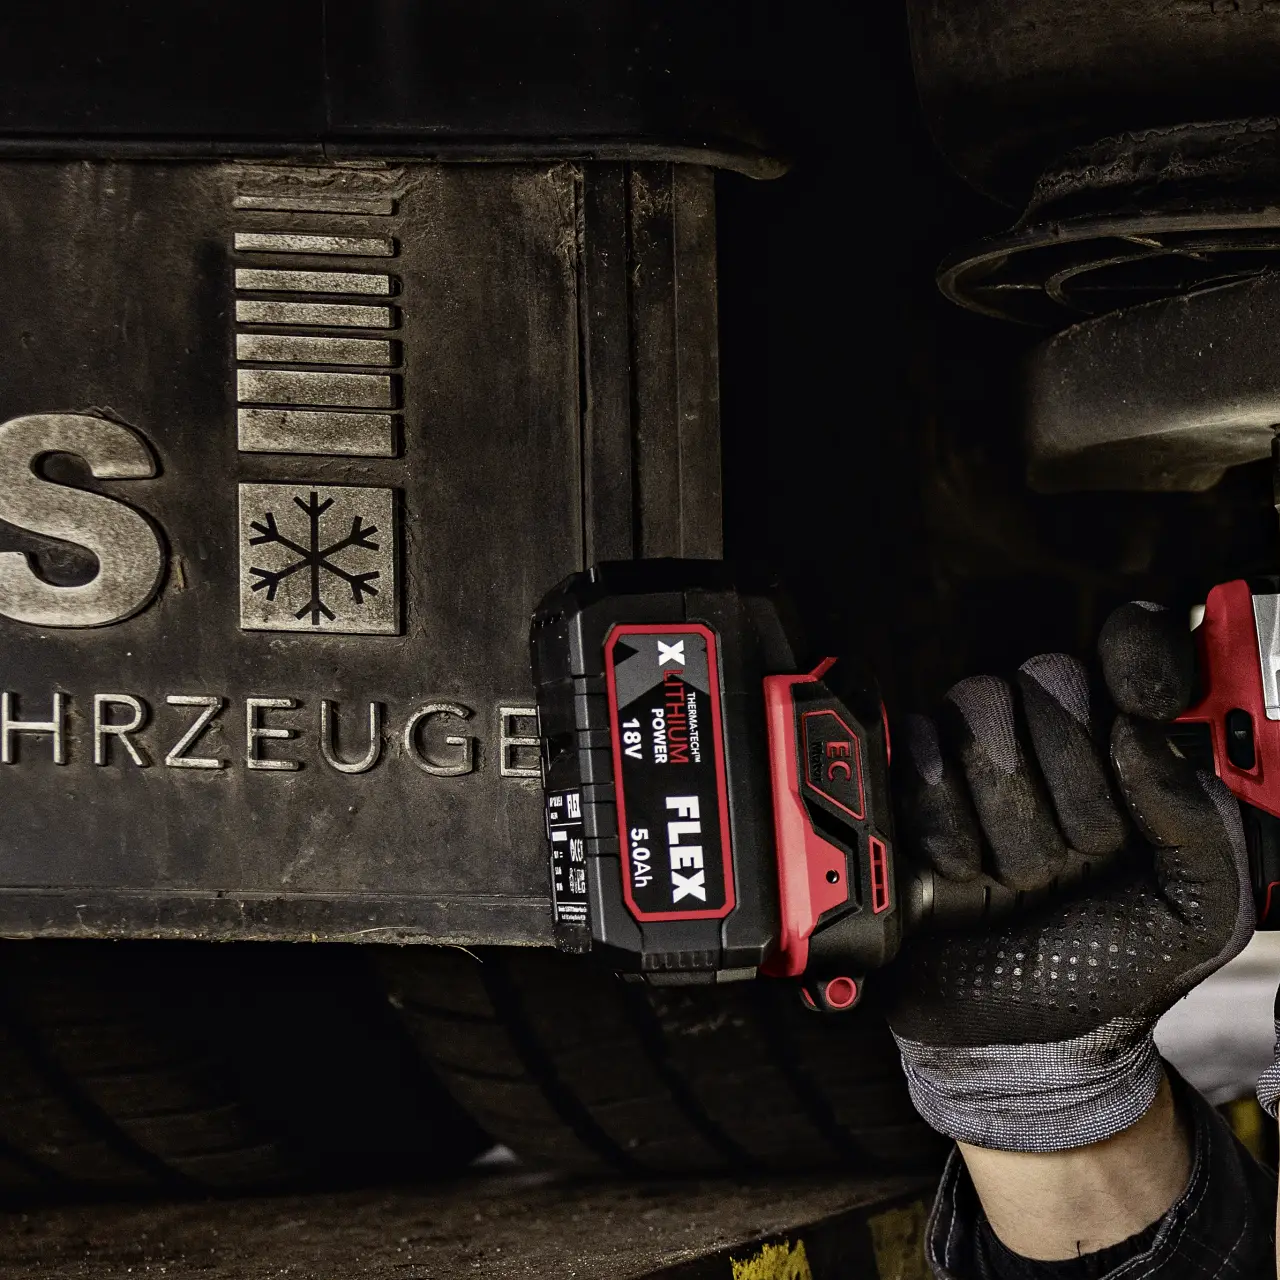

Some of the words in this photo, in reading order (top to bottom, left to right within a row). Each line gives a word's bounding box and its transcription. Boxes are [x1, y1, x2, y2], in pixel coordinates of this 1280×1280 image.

[0, 413, 163, 628] S
[622, 717, 643, 760] 18V
[651, 708, 668, 764] POWER
[663, 669, 689, 764] LITHIUM
[826, 741, 852, 782] EC
[630, 827, 653, 888] 5.0Ah
[665, 795, 707, 904] FLEX
